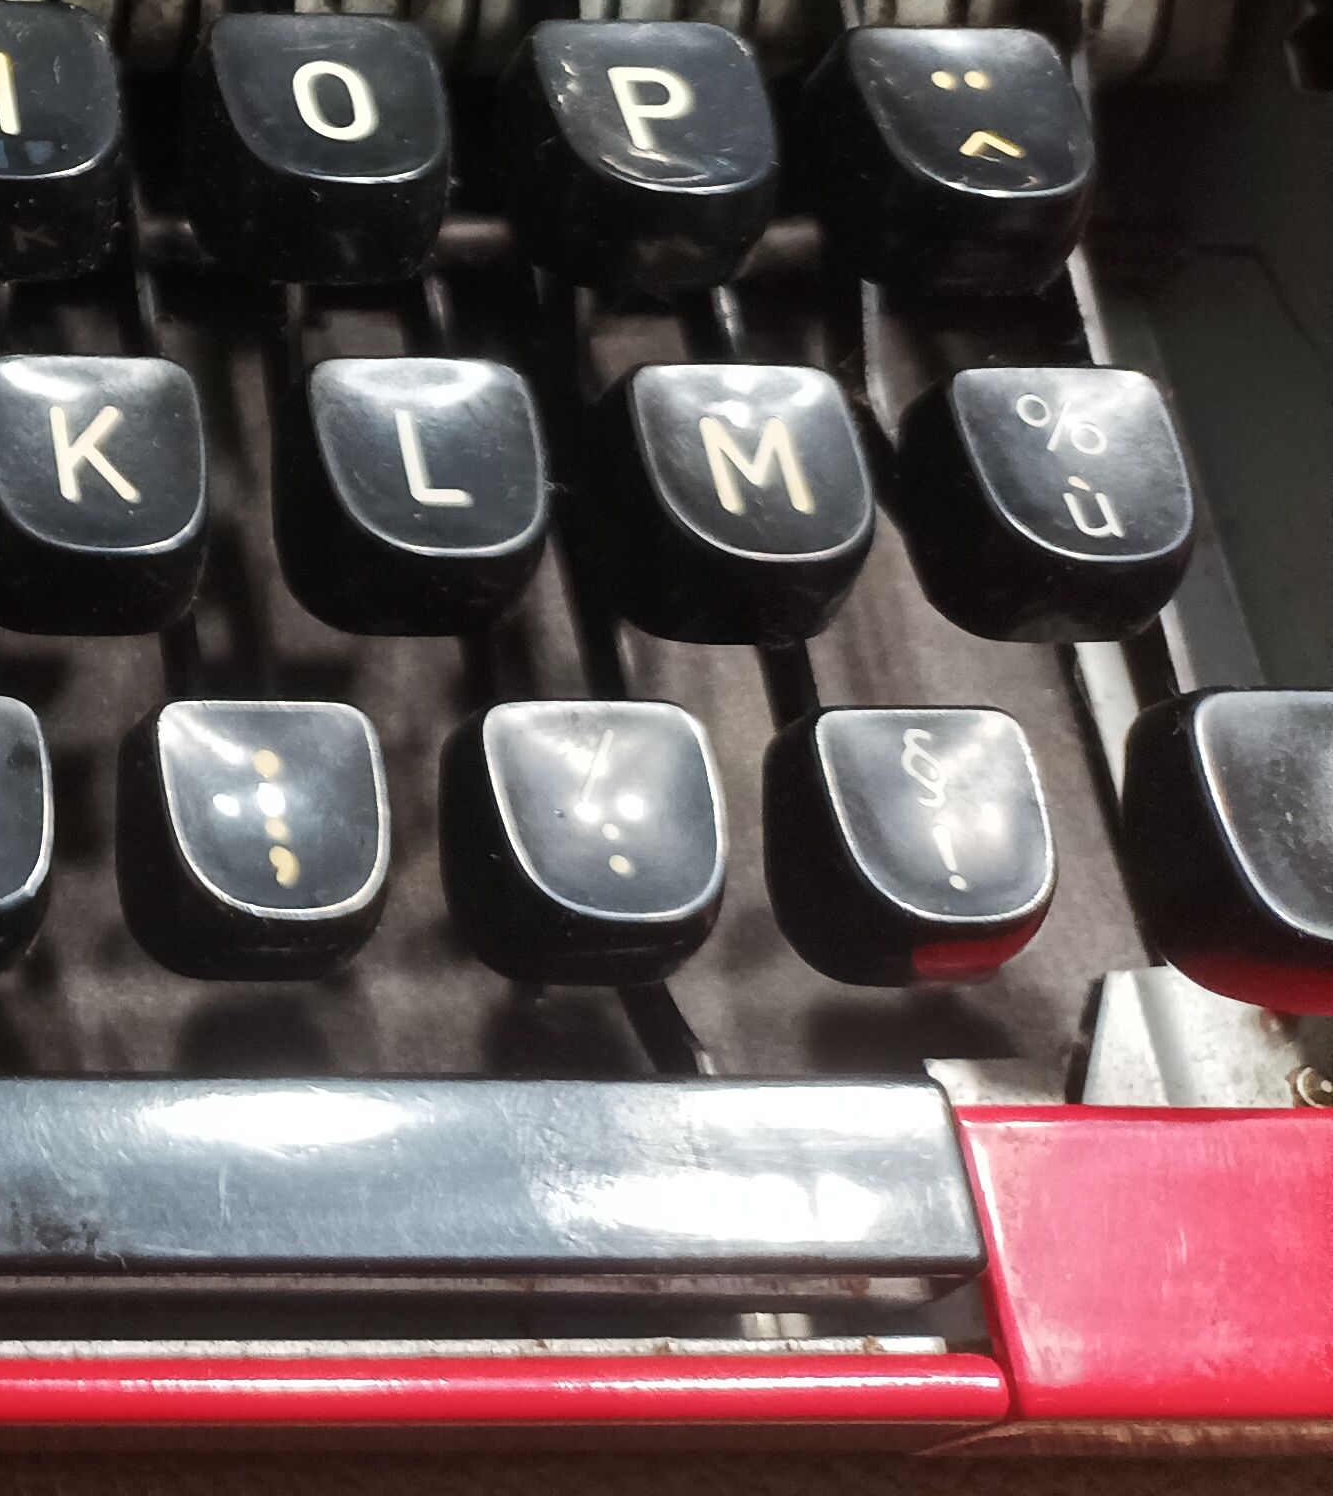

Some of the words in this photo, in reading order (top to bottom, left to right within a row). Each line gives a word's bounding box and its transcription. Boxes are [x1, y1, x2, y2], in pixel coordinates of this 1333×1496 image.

[292, 60, 378, 141] O
[607, 66, 694, 152] P
[45, 402, 141, 506] K
[397, 408, 472, 506] L
[695, 412, 817, 516] M
[1013, 388, 1113, 458] %
[1059, 472, 1127, 540] ù
